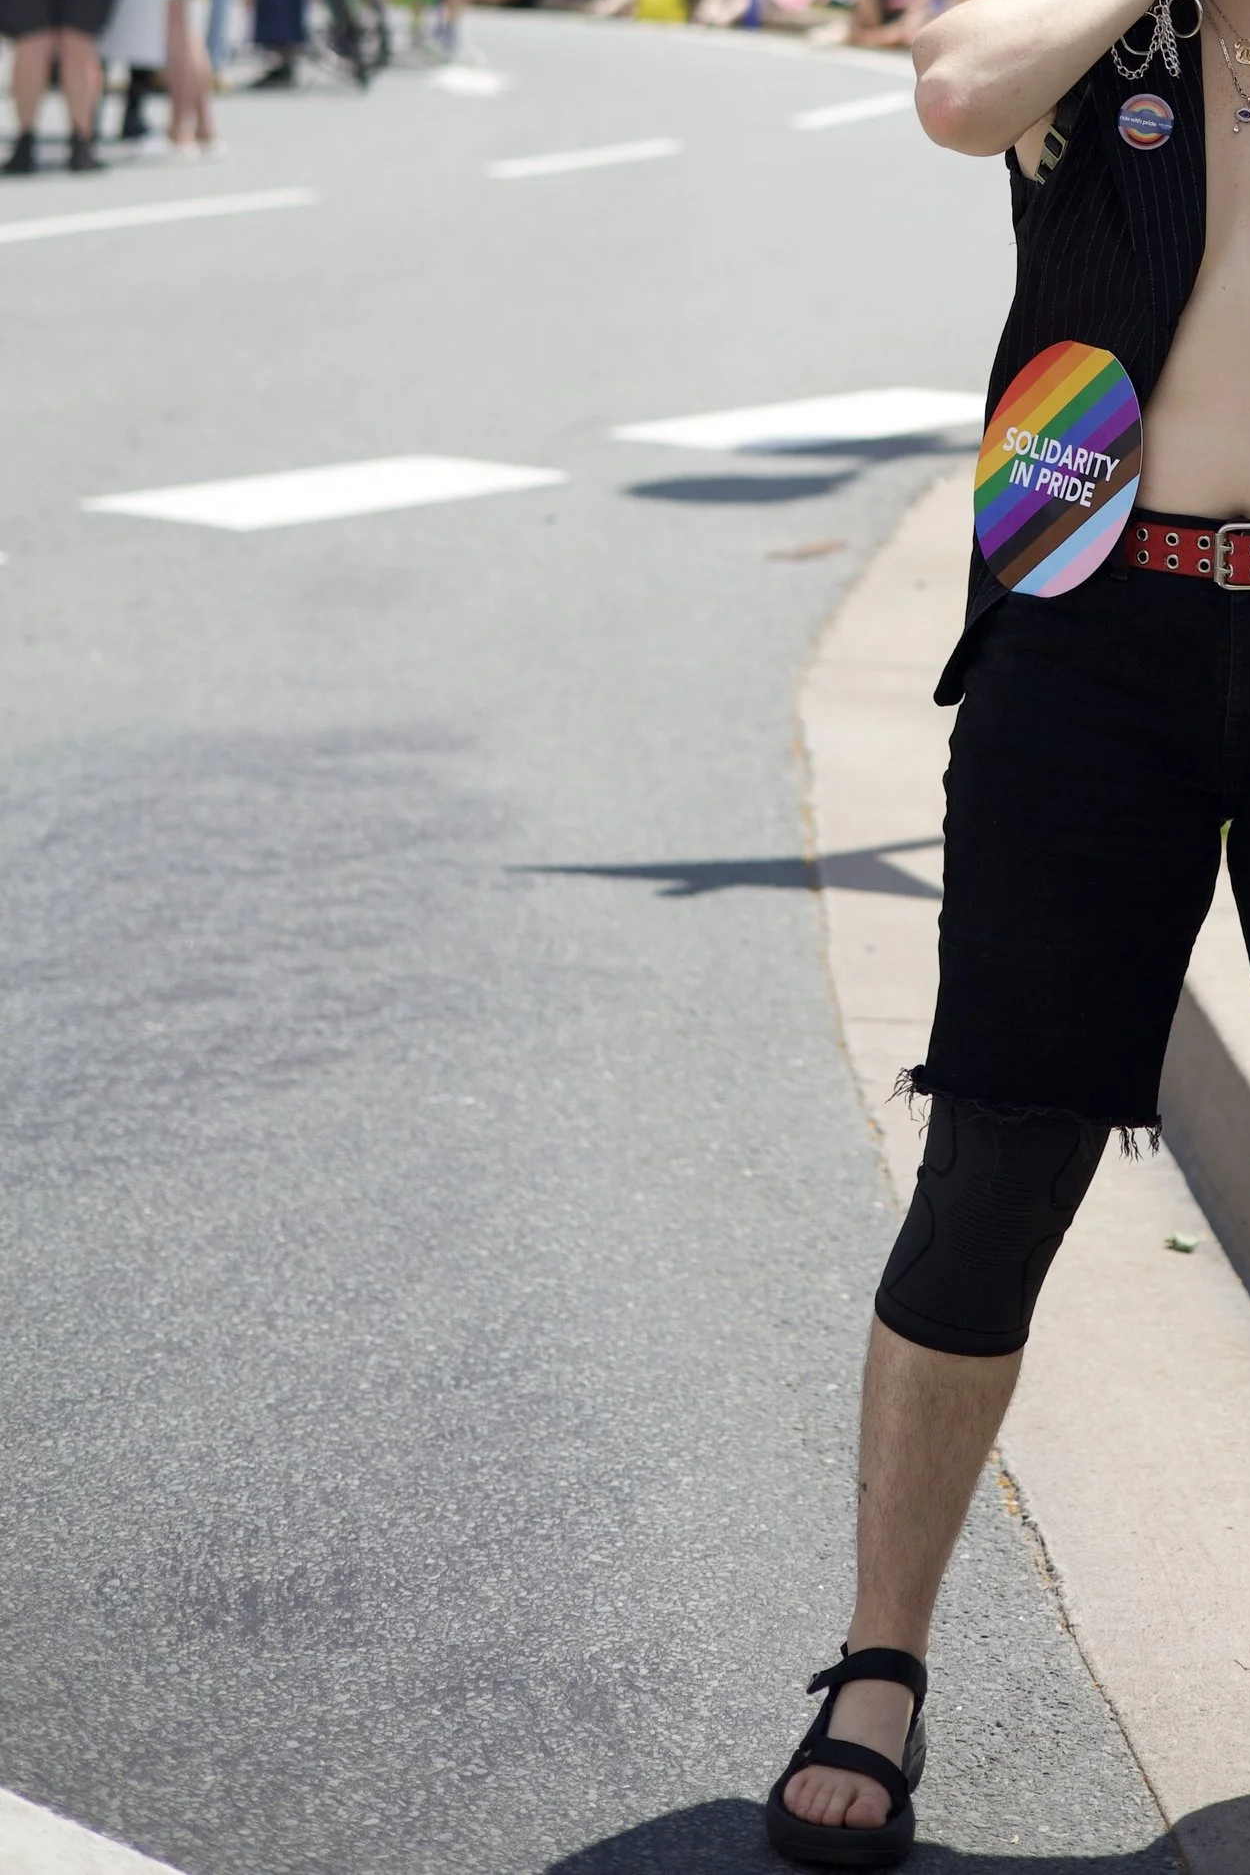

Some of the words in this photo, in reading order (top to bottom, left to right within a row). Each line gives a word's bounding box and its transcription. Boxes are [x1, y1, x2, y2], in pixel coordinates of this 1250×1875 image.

[1002, 427, 1120, 482] SOLIDARITY
[1009, 459, 1034, 488] IN
[1035, 467, 1096, 508] PRIDE
